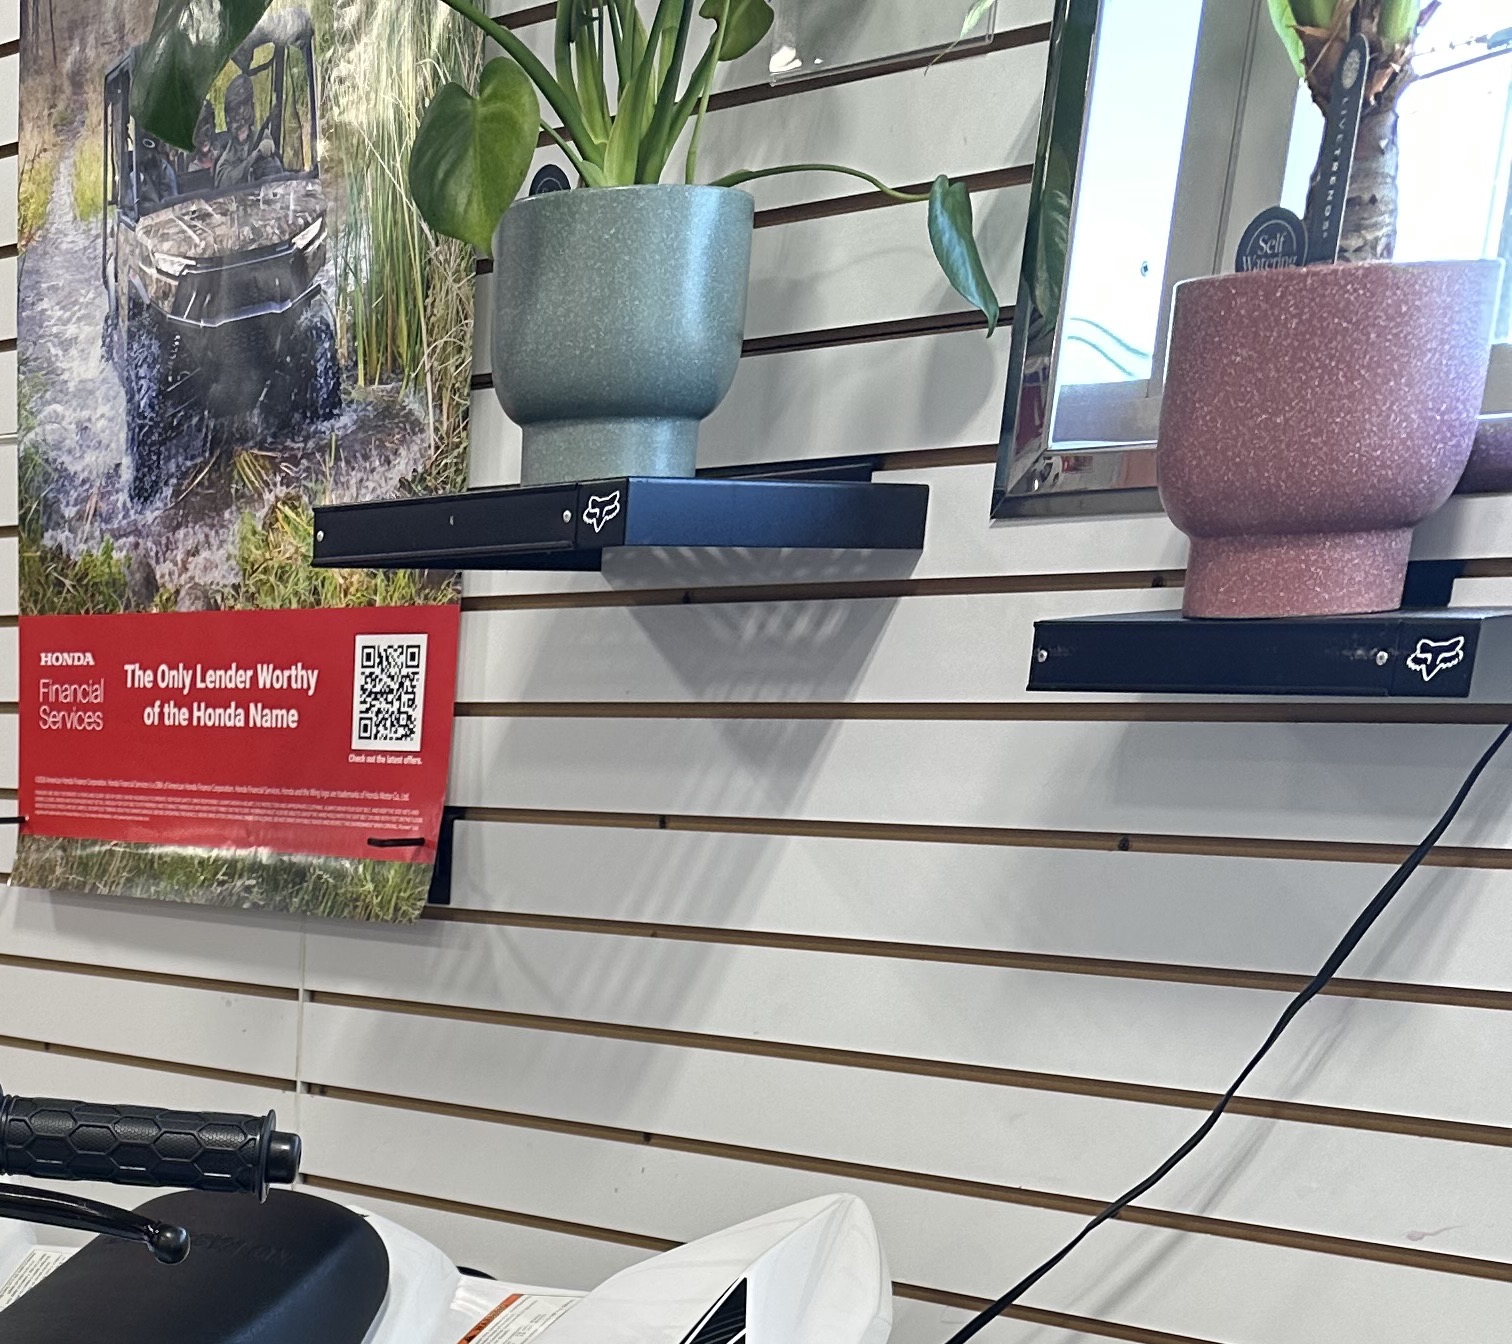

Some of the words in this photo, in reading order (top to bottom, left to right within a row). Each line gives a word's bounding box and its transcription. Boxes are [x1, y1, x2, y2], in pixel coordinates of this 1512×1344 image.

[1257, 232, 1287, 256] Self
[39, 652, 95, 666] HONDA
[39, 678, 105, 704] Financial
[124, 663, 154, 689] The
[157, 662, 193, 696] Only
[196, 662, 254, 689] Lender
[257, 662, 319, 697] Worthy
[39, 705, 104, 731] Services
[143, 700, 161, 726] of
[163, 700, 189, 727] the
[192, 702, 245, 728] Honda
[248, 702, 299, 729] Name
